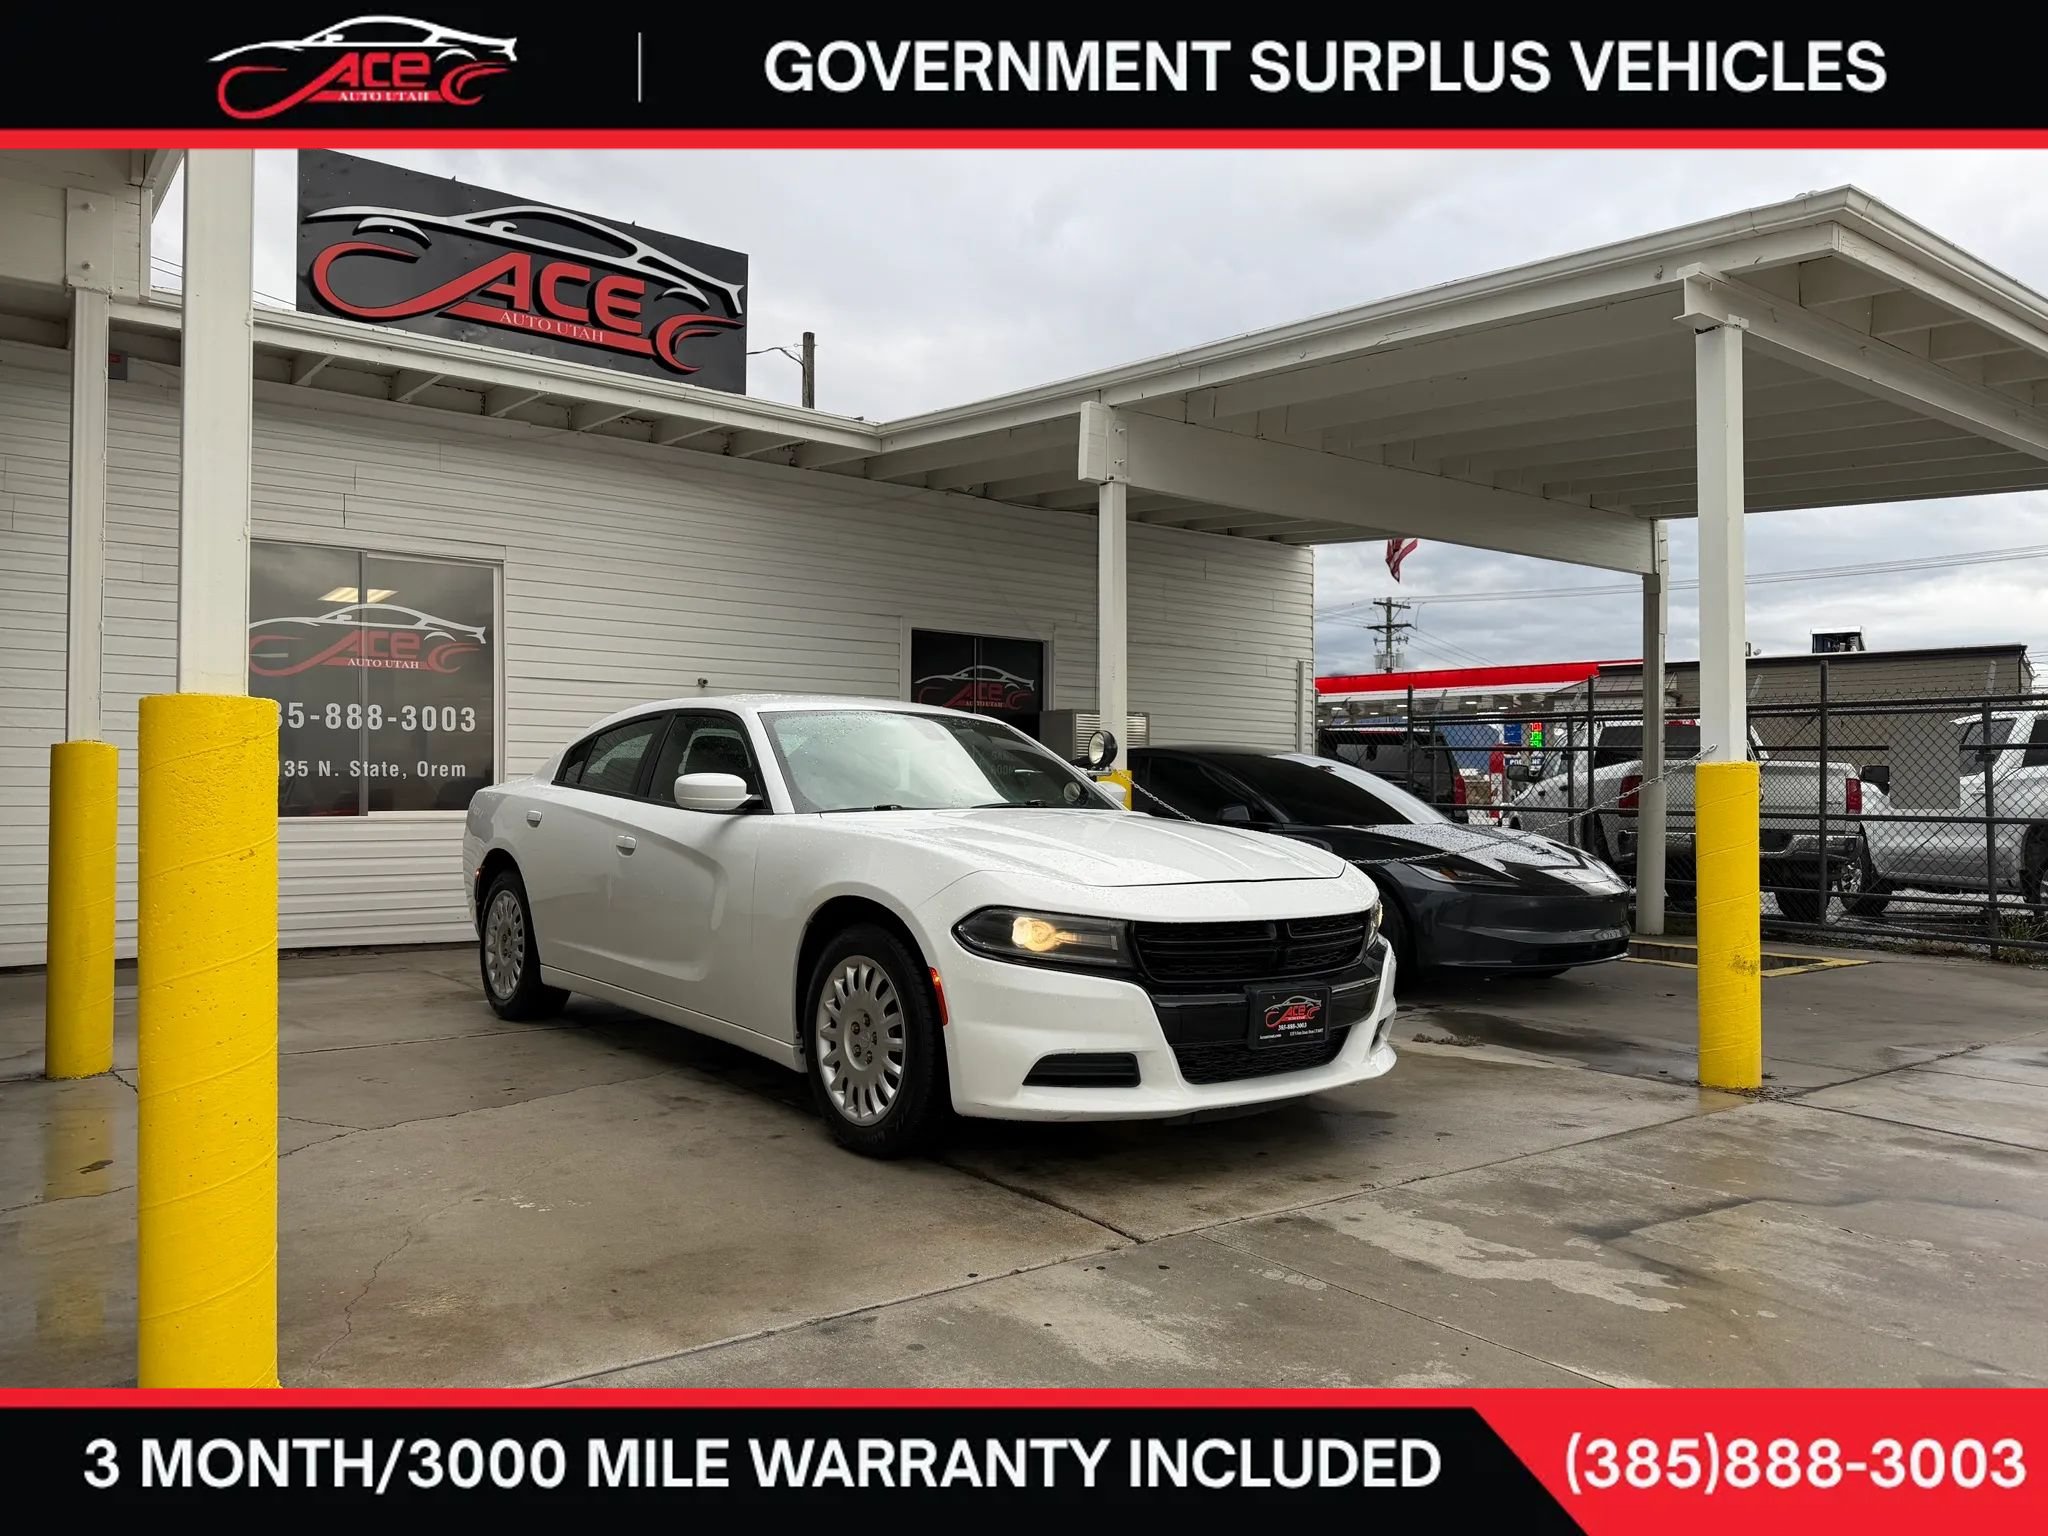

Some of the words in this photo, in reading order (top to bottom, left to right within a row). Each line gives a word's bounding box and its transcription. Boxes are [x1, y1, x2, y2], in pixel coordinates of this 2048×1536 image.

[473, 251, 646, 335] ACE
[500, 310, 552, 333] AUTO
[555, 321, 605, 344] UTAH
[347, 657, 382, 668] AUTO
[385, 659, 419, 670] UTAH
[318, 760, 340, 777] N.
[349, 760, 407, 780] State,
[416, 760, 467, 778] Orem
